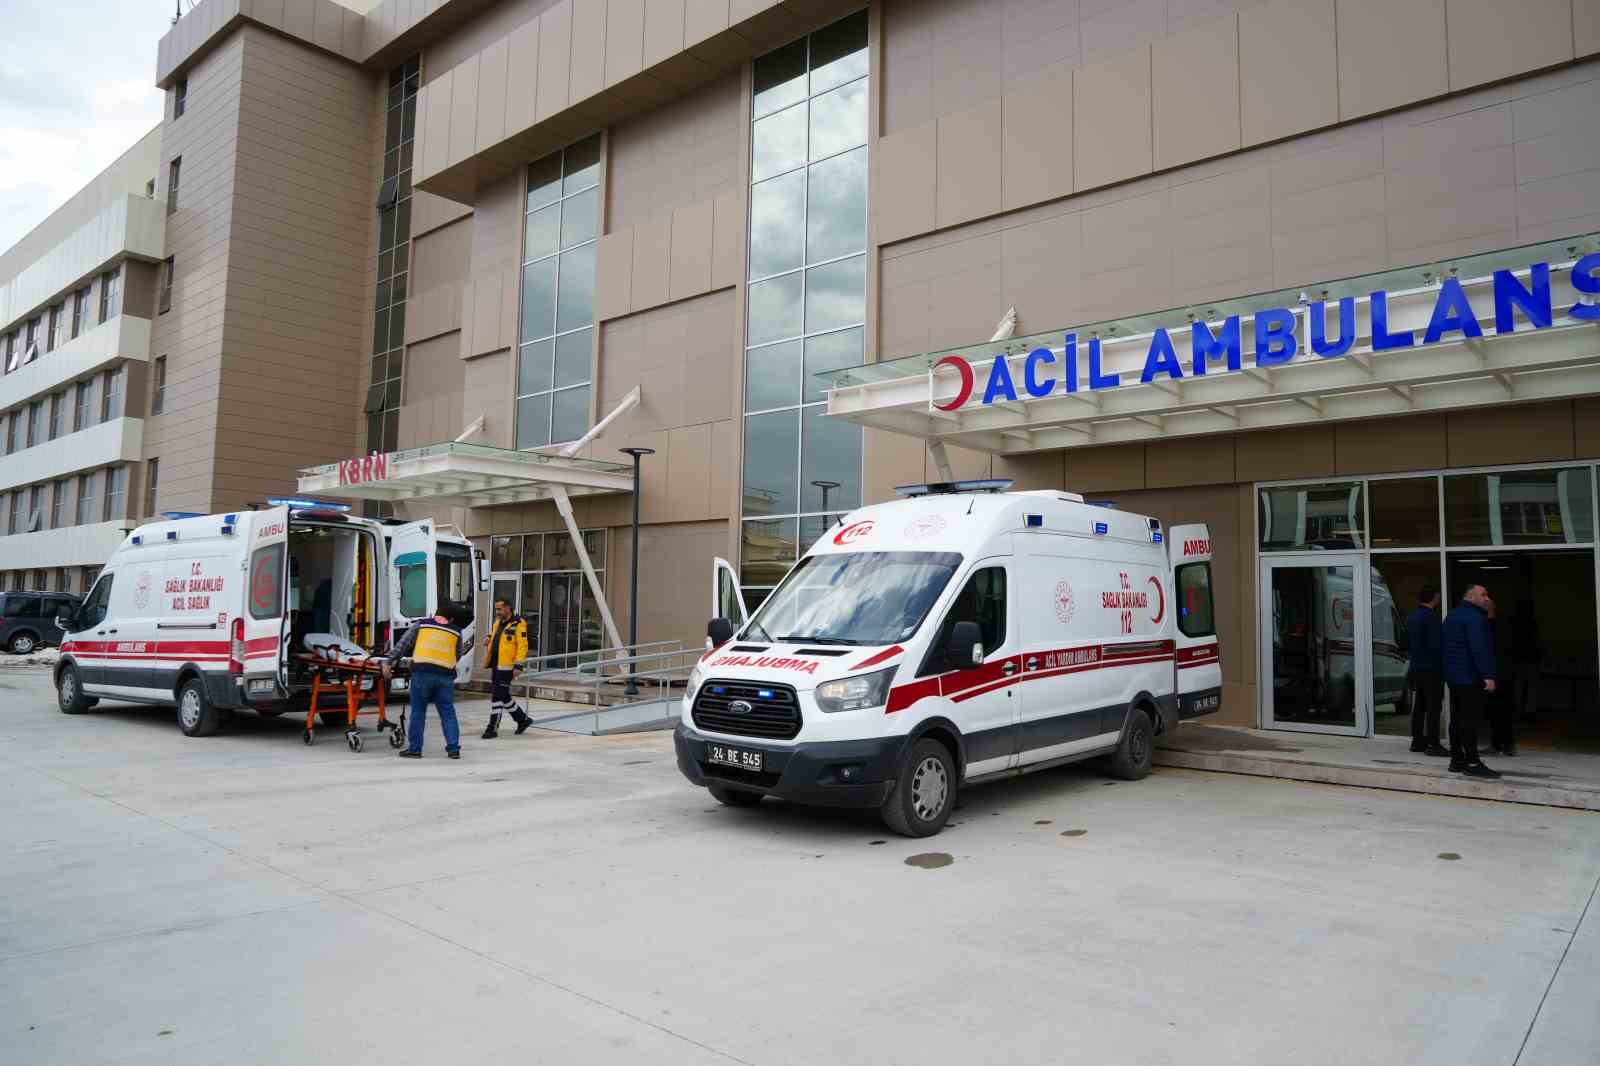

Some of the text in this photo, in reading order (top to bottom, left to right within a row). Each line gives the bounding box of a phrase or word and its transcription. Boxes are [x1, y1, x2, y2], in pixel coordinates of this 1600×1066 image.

[982, 252, 1600, 404] ACİL AMBULANS
[339, 453, 387, 484] KBRN
[1121, 609, 1132, 634] 112
[713, 746, 761, 766] 24 BE 545
